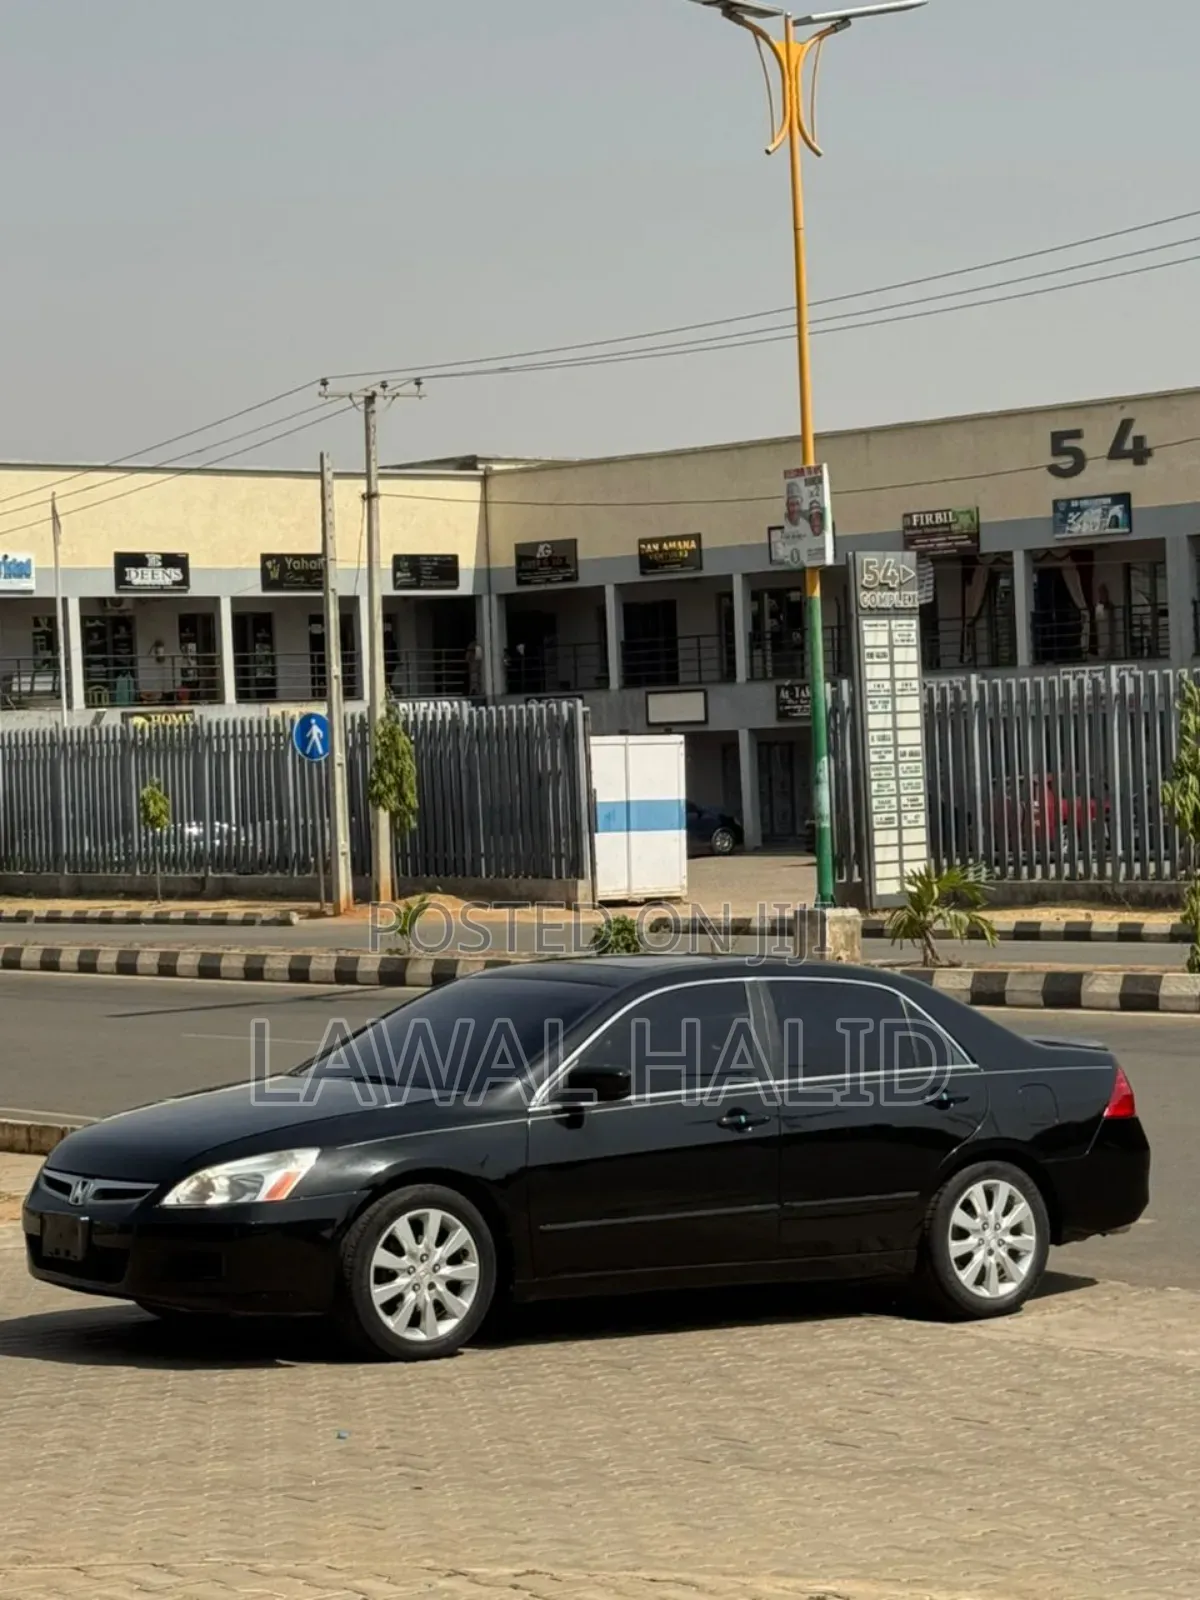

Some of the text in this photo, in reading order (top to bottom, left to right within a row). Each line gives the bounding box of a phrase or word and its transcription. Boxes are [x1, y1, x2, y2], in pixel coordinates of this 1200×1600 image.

[912, 511, 957, 526] FIRBIL
[125, 567, 183, 581] DEENS
[861, 557, 900, 587] 54
[859, 591, 919, 607] COMPLEX
